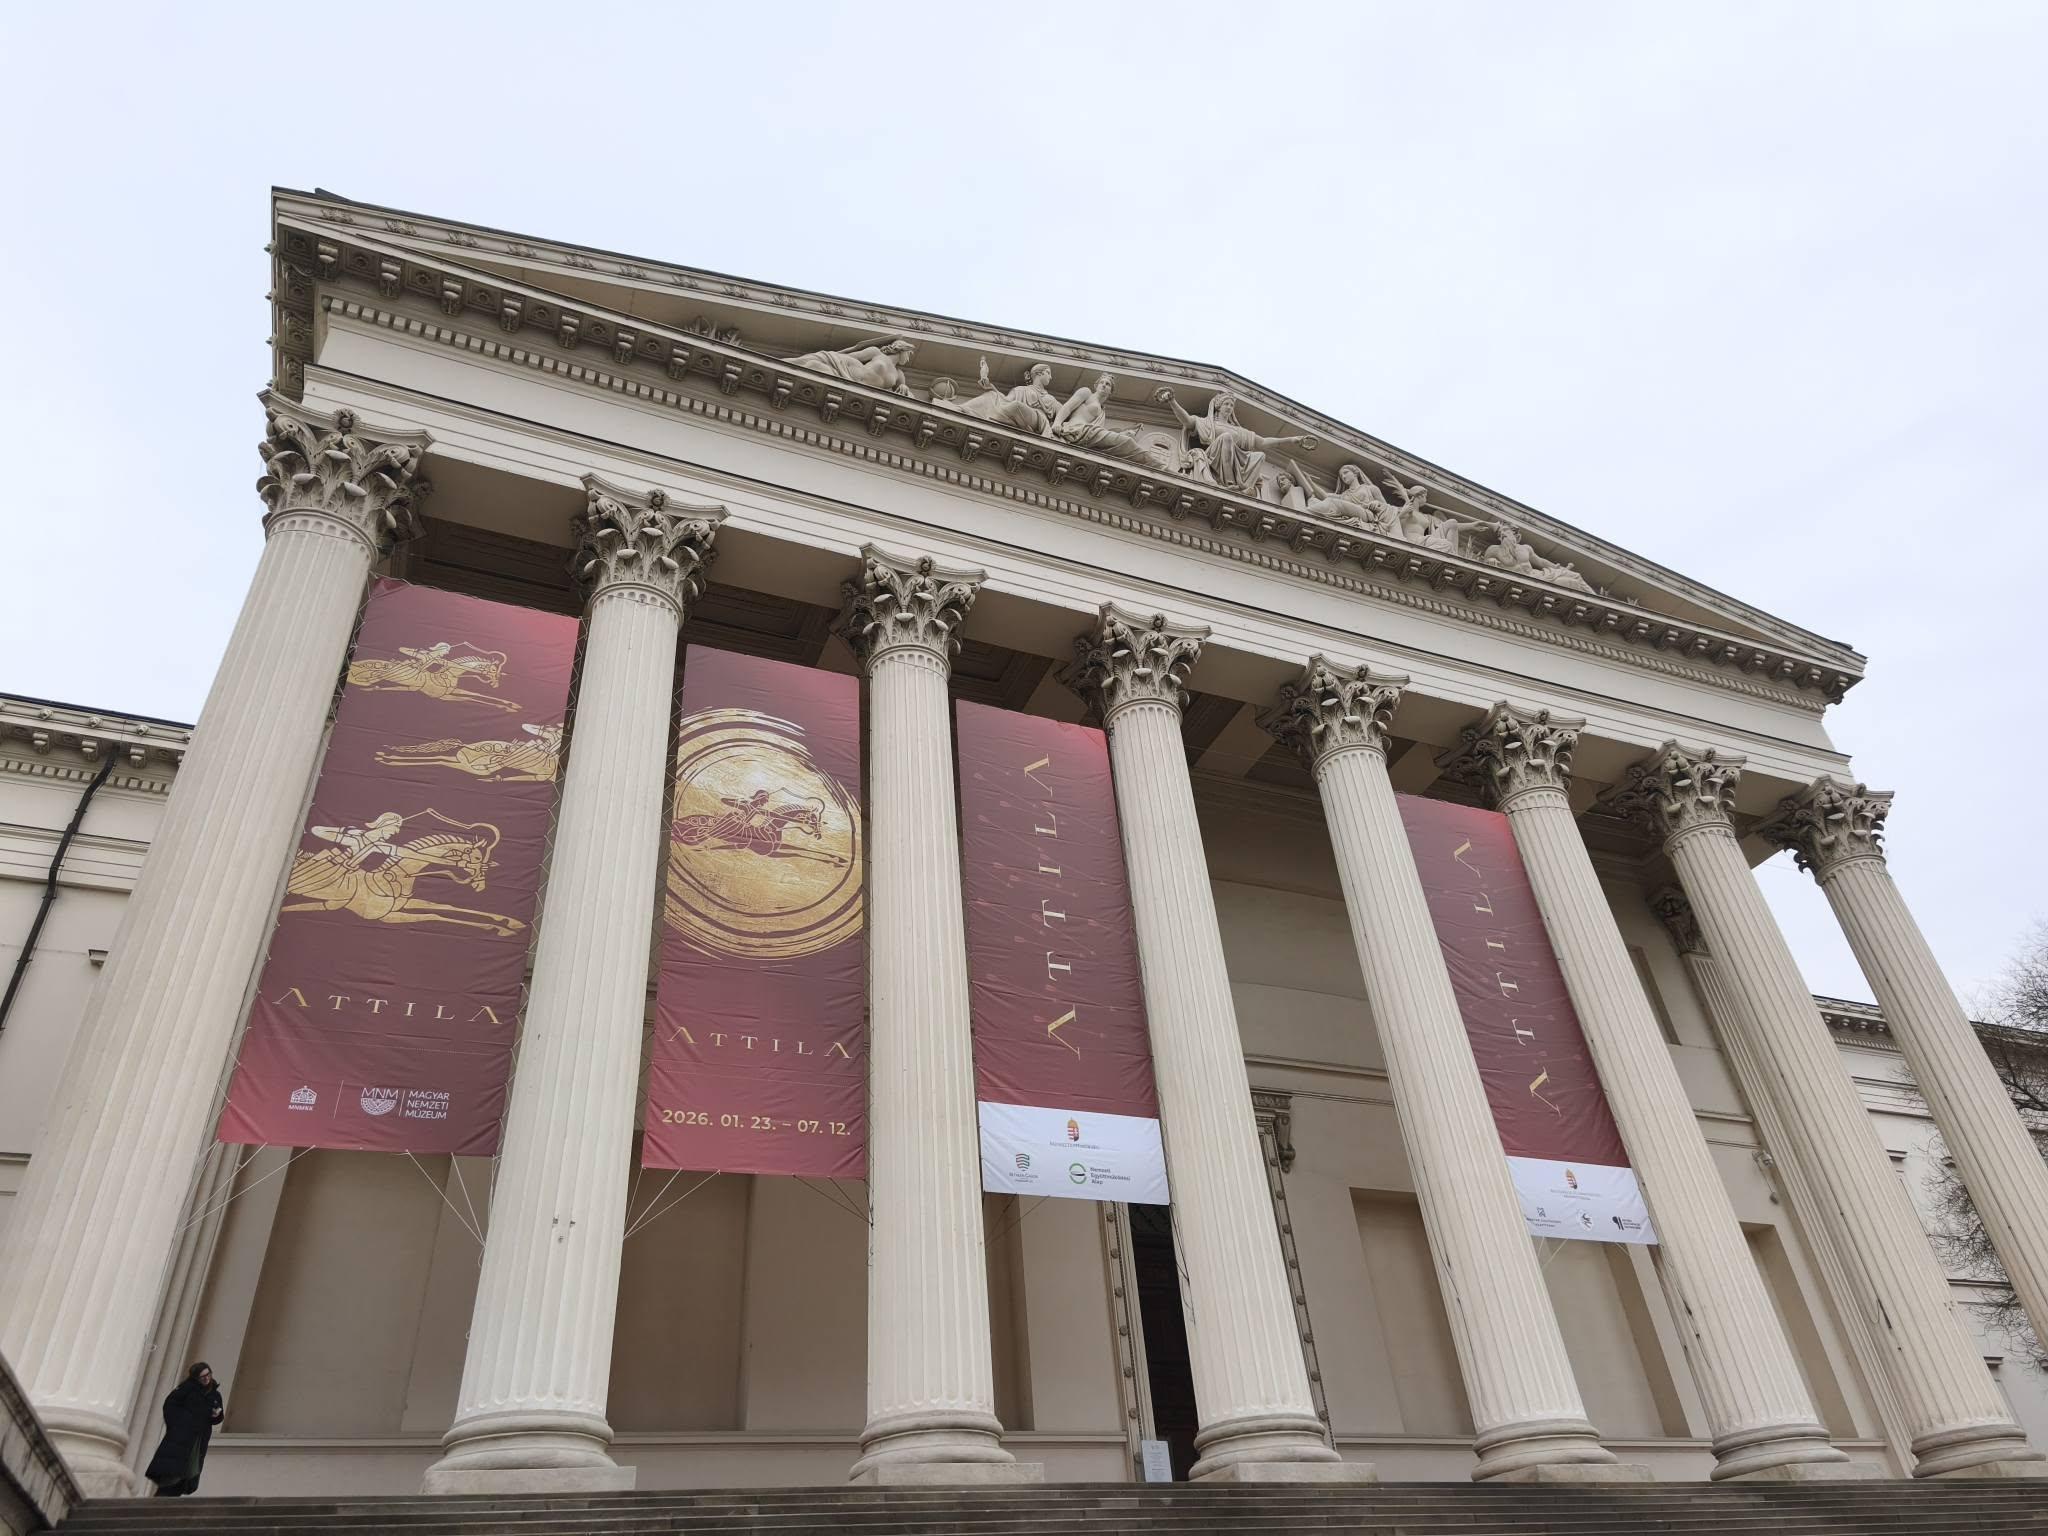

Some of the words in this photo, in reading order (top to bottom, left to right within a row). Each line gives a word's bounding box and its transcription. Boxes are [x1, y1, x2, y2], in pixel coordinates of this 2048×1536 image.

[1024, 753, 1081, 1061] ATTILA
[1454, 838, 1562, 1118] ATTILA
[272, 986, 503, 1025] ATTILA
[667, 1026, 852, 1059] ATTILA
[360, 1087, 399, 1099] MNM
[406, 1100, 449, 1110] NEMZETI
[408, 1090, 450, 1101] MAGYAR
[405, 1108, 447, 1120] MÚZEUM
[661, 1109, 714, 1126] 2026.
[720, 1113, 744, 1128] 01.
[751, 1116, 777, 1130] 23.
[797, 1119, 823, 1134] 07.
[829, 1121, 851, 1136] 12.
